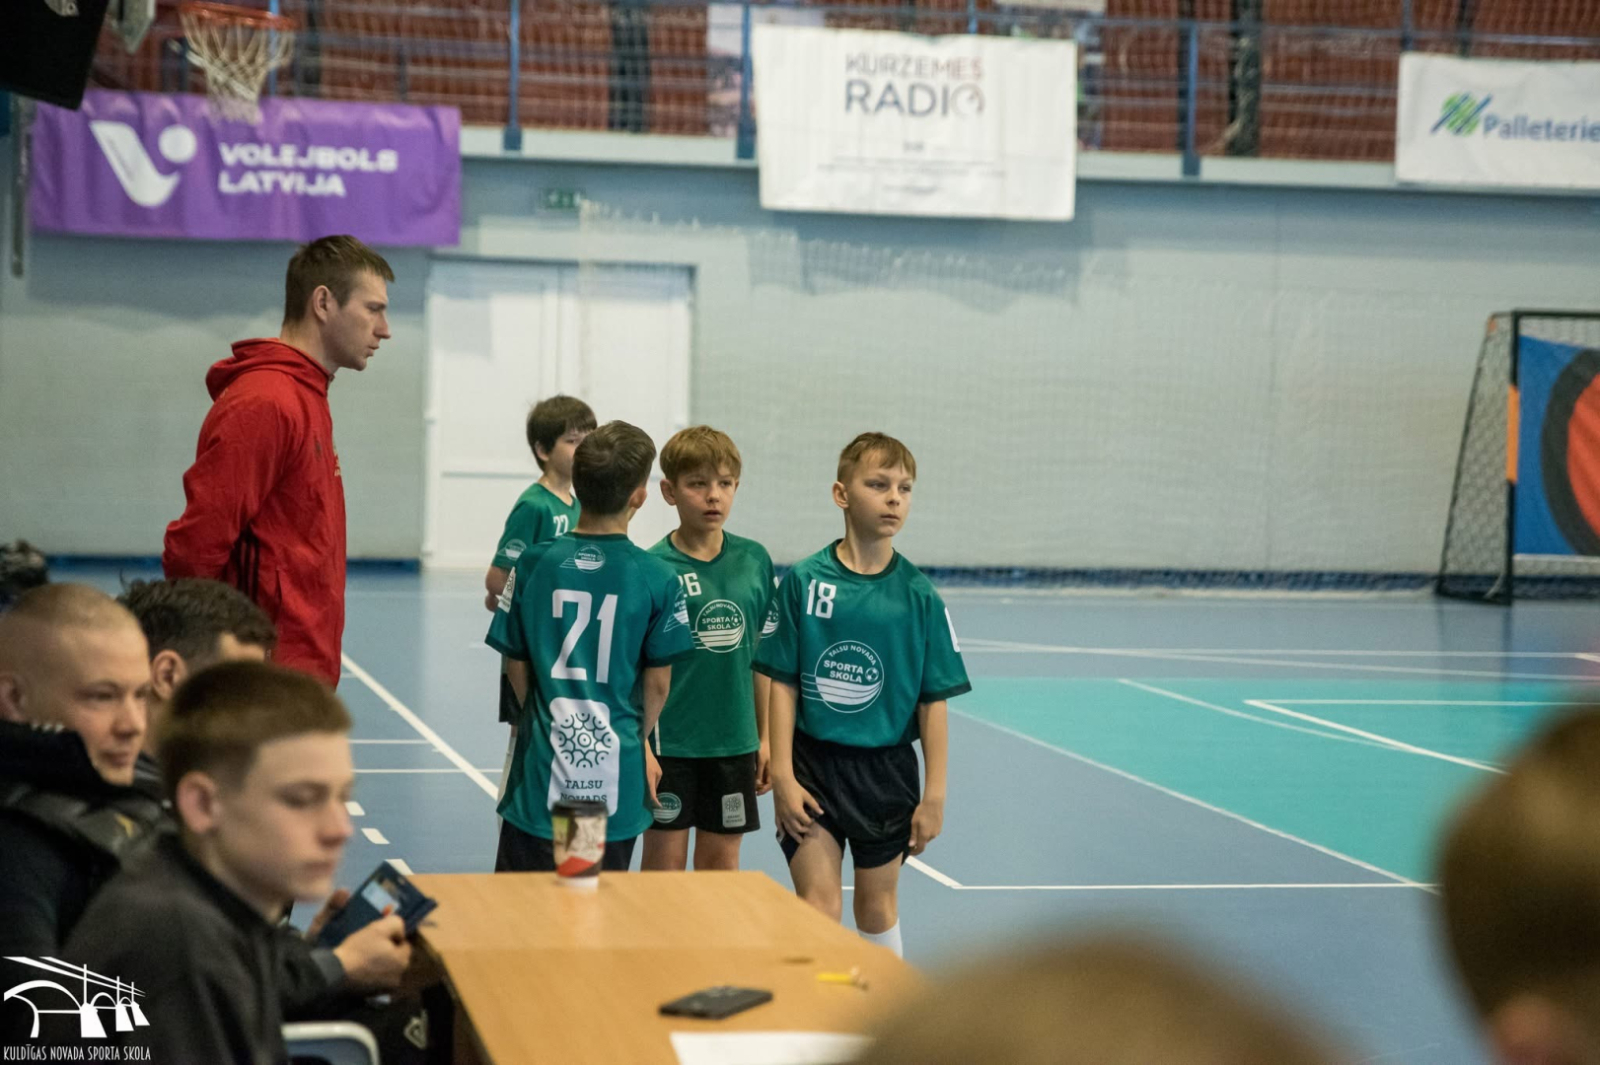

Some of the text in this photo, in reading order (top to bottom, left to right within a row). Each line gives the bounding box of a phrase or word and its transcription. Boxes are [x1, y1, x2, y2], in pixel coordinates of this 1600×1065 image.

[845, 53, 984, 80] KURZEMES
[845, 79, 986, 118] RADIO
[218, 142, 398, 173] VOLEJBOLS
[218, 170, 347, 197] LATVIJA
[806, 579, 837, 619] 18
[702, 616, 730, 624] SPORTA
[551, 588, 619, 684] 21
[823, 659, 863, 674] SPORTA
[828, 644, 877, 666] TALSU NOVADA
[829, 670, 863, 683] SKOLA
[565, 779, 603, 790] TALSU
